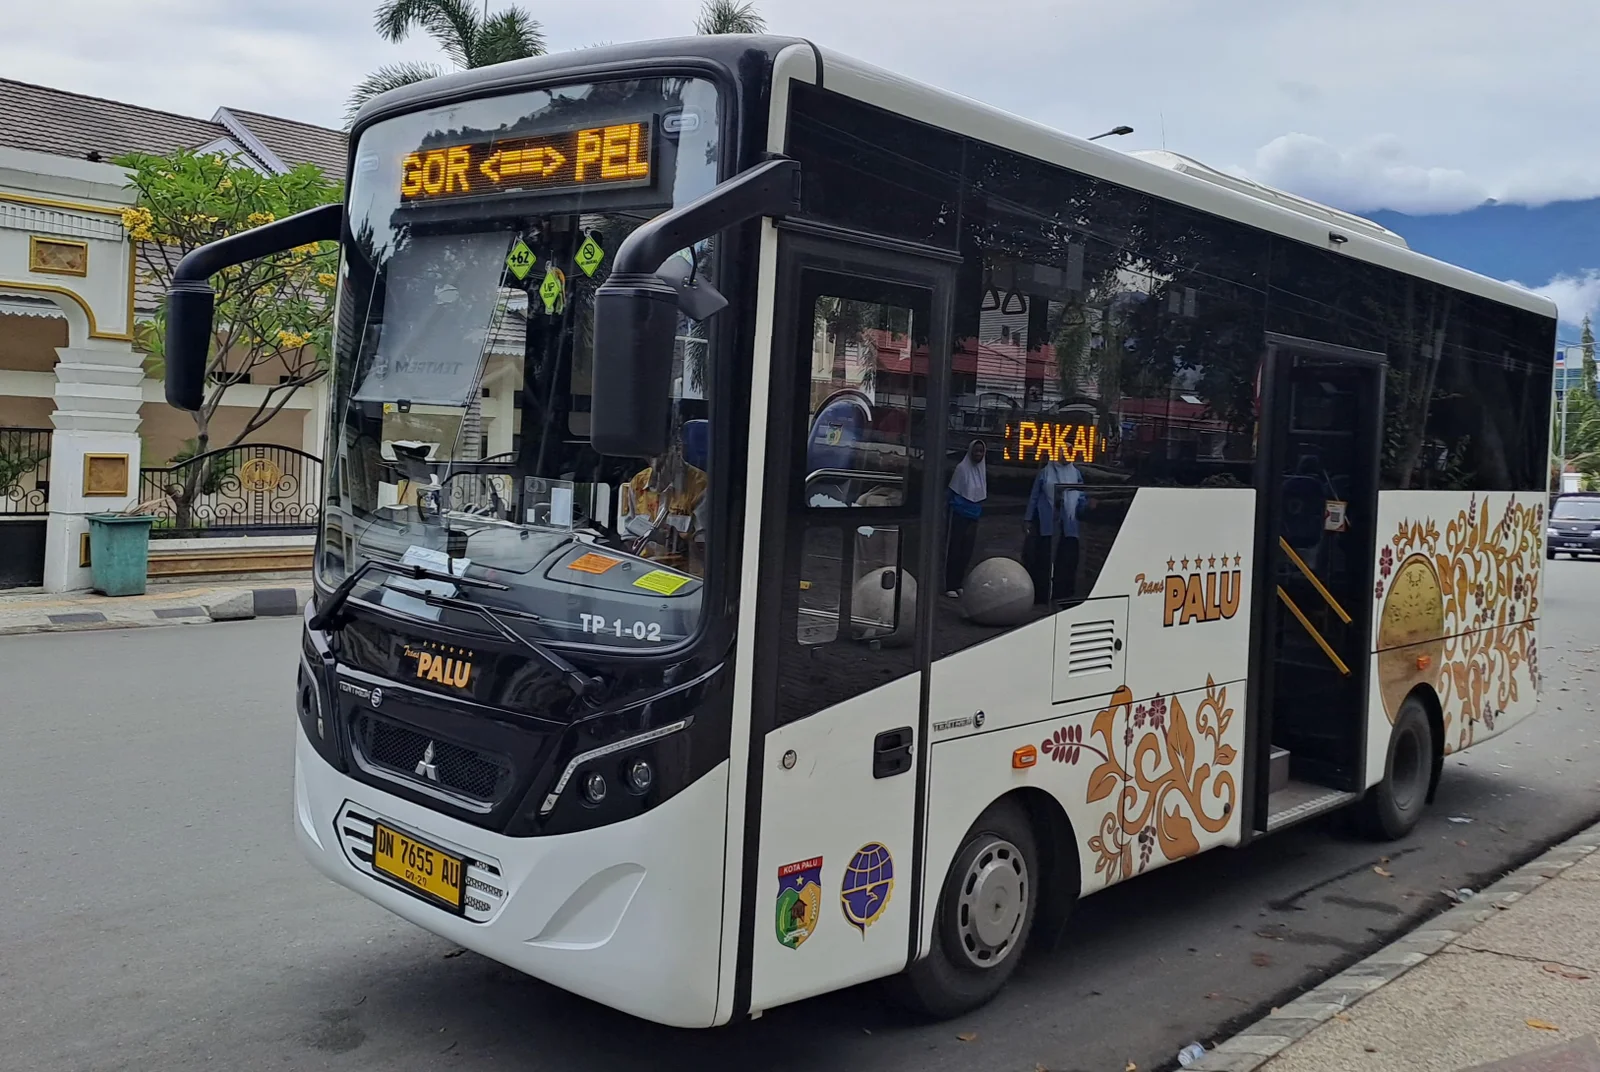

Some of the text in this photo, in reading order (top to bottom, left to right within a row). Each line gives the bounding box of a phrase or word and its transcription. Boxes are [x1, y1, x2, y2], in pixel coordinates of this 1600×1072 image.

[401, 123, 648, 196] GOR PEL
[510, 250, 530, 264] +62
[1019, 421, 1096, 462] PAKAI
[1163, 569, 1241, 627] PALU
[580, 613, 661, 641] TP 1-02
[416, 651, 472, 689] PALU
[378, 828, 459, 889] DN 7655 AU
[783, 859, 818, 874] KOTA PALU
